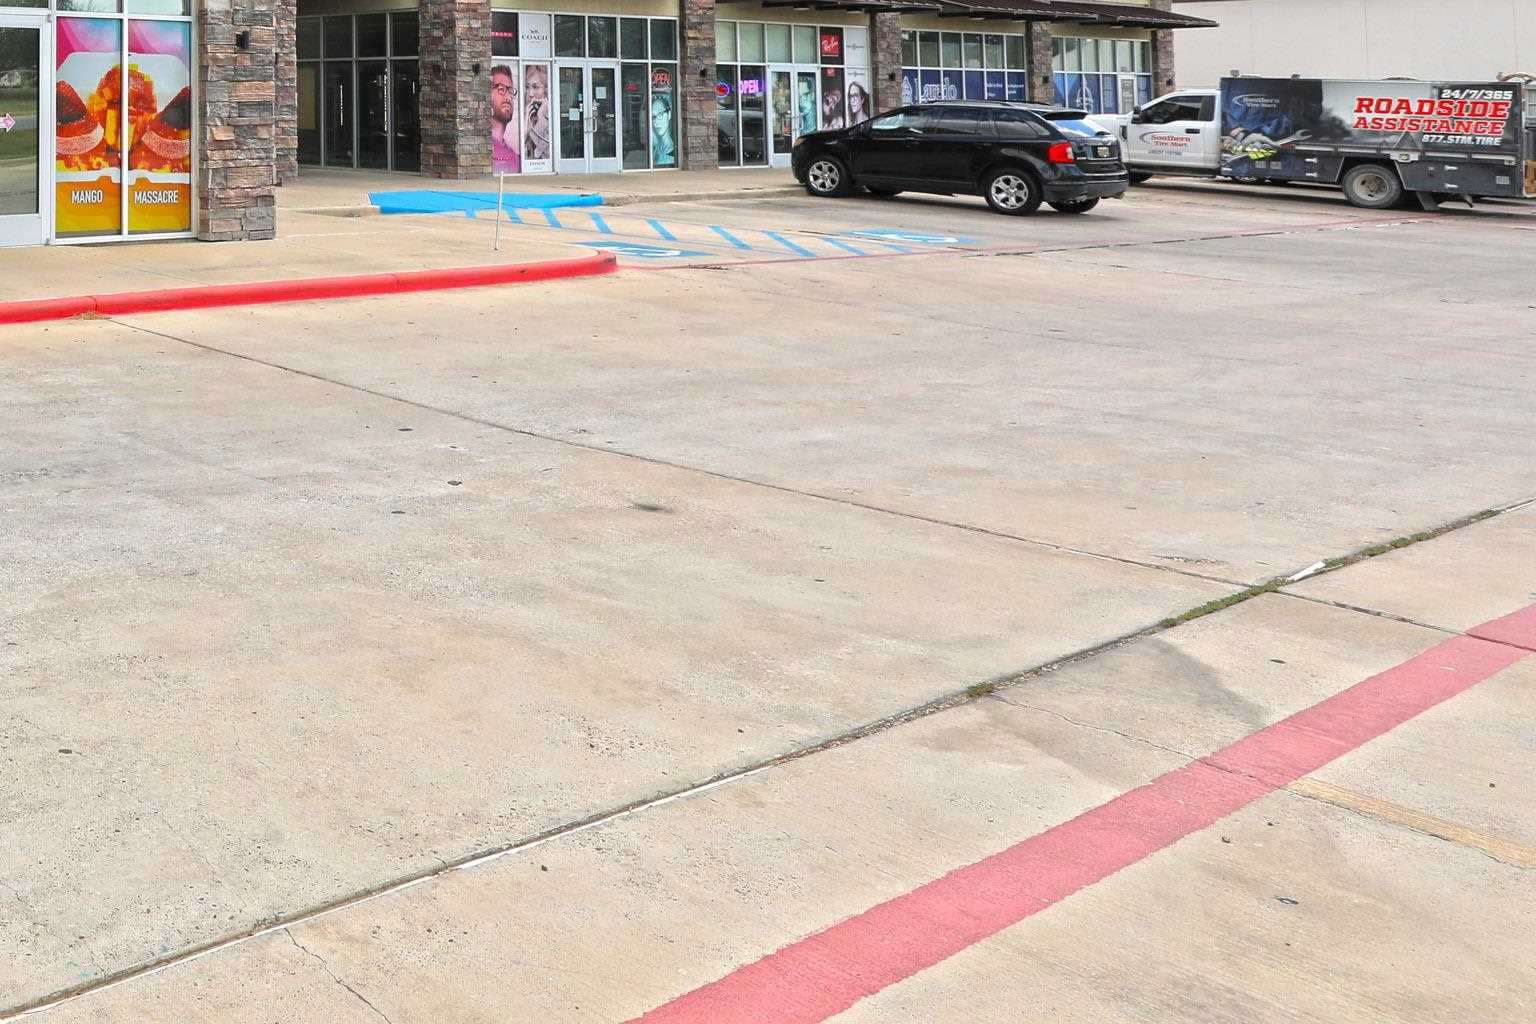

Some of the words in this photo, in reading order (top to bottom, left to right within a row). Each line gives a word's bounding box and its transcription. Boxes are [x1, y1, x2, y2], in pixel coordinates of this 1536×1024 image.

[738, 79, 759, 94] OPEN
[1441, 89, 1514, 100] 24/7/365
[1353, 96, 1512, 119] ROADSIDE
[1352, 116, 1505, 136] ASSISTANCE
[1151, 134, 1191, 142] Southern
[1421, 134, 1502, 146] 877.STM.TIRE
[71, 189, 104, 204] MANGO
[134, 190, 179, 204] MASSACRE
